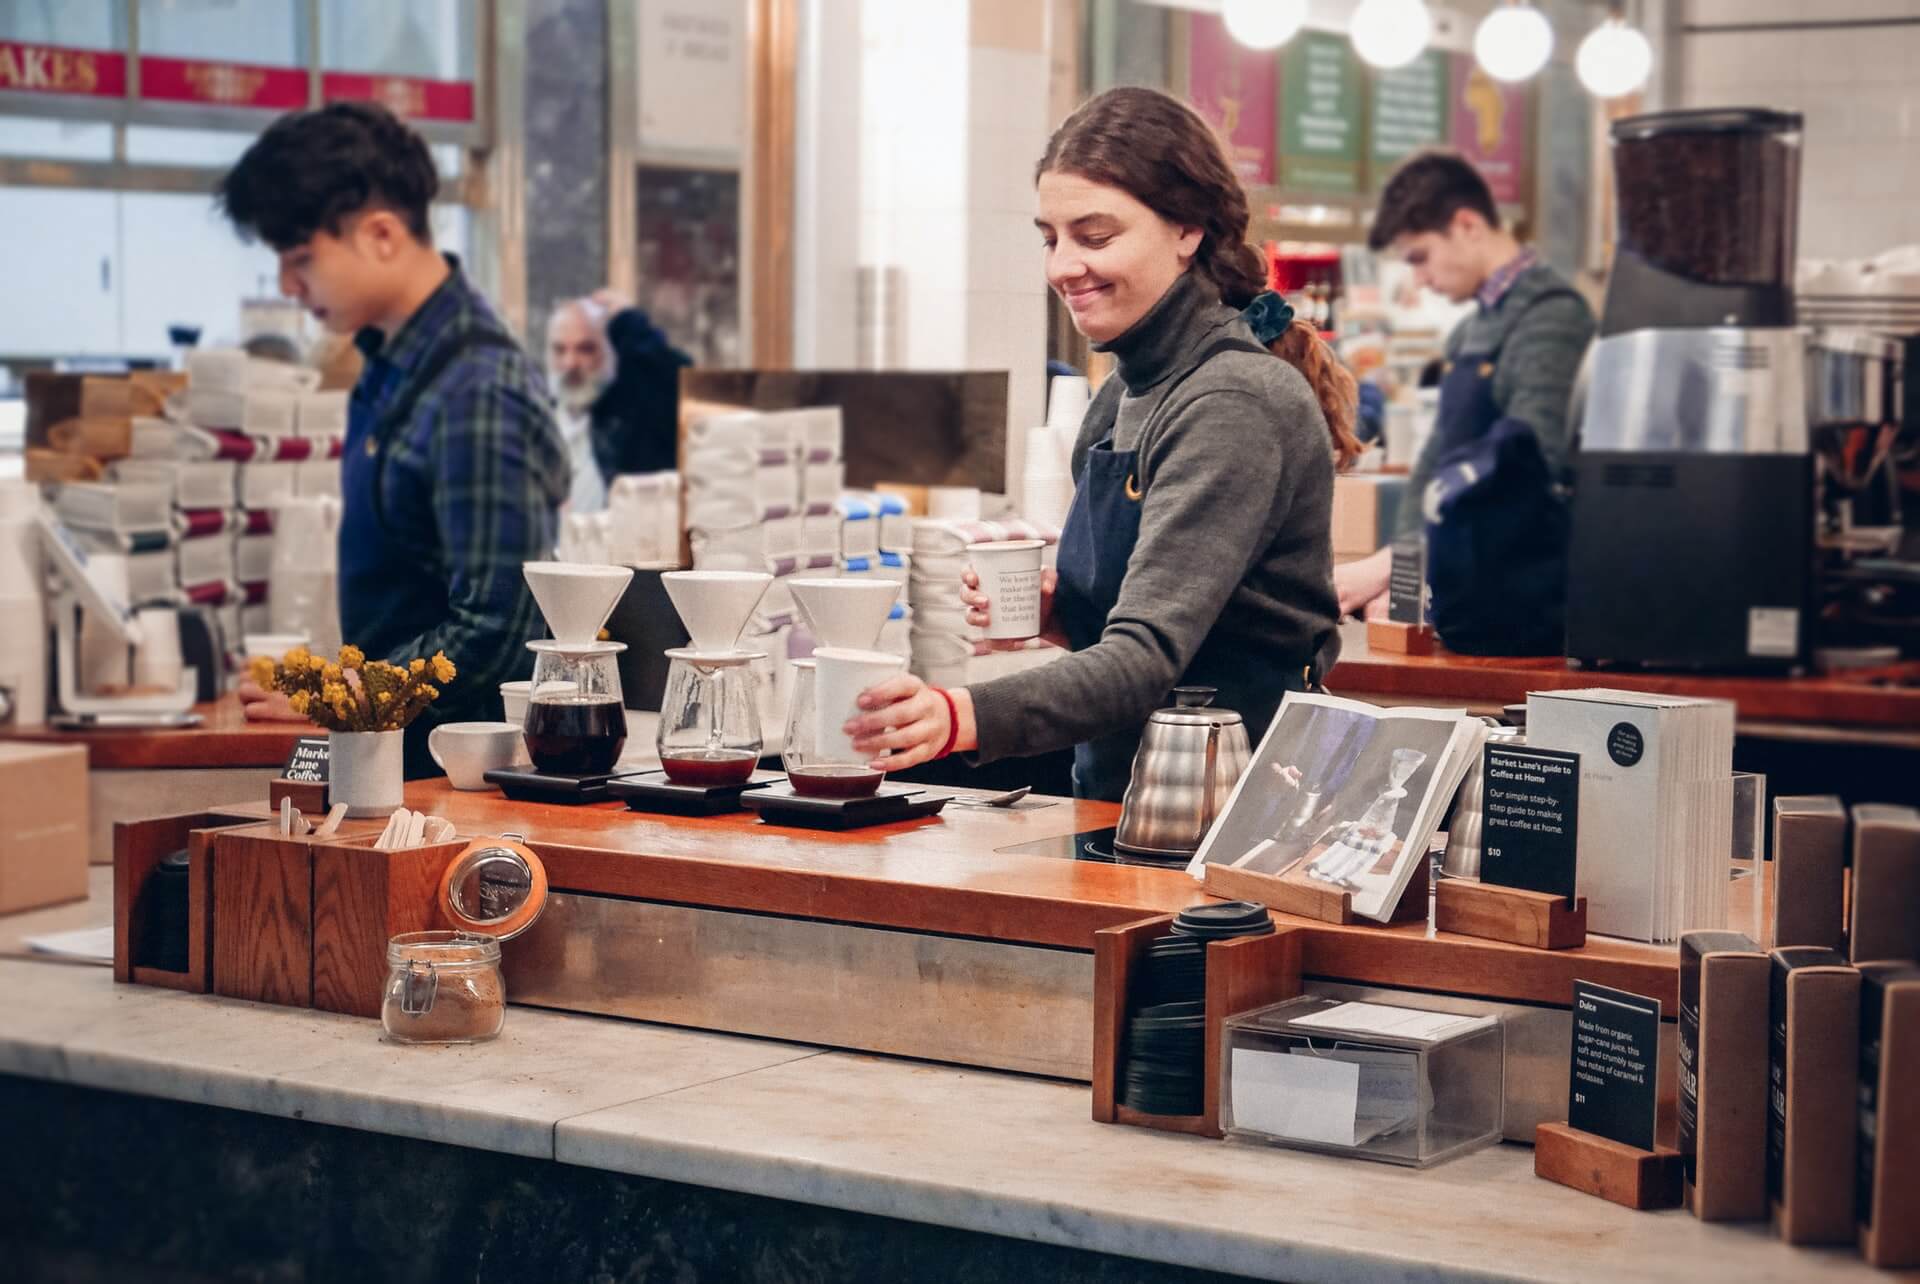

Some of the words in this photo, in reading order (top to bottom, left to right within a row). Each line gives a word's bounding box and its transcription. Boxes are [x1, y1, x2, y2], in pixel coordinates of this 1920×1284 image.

[295, 746, 330, 760] Marke
[290, 758, 320, 770] Lane
[1490, 757, 1517, 768] Market
[1518, 760, 1541, 771] Lane's
[1542, 764, 1562, 774] guide
[1563, 766, 1572, 775] to
[286, 769, 323, 782] Coffee
[1490, 768, 1514, 779] Coffee
[1514, 772, 1524, 781] at
[1524, 773, 1546, 784] Home
[1489, 788, 1505, 798] Our
[1505, 791, 1529, 802] simple
[1489, 803, 1506, 813] step
[1506, 806, 1527, 815] guide
[1527, 808, 1536, 817] to
[1536, 810, 1562, 822] making
[1488, 817, 1509, 826] great
[1509, 820, 1532, 830] coffee
[1532, 823, 1541, 831] at
[1541, 824, 1563, 834] home.
[1487, 847, 1502, 857] $10
[1579, 999, 1597, 1013] Dulce
[1578, 1019, 1595, 1032] Made
[1595, 1023, 1610, 1036] from
[1610, 1029, 1633, 1042] organic
[1577, 1046, 1590, 1056] soft
[1590, 1049, 1602, 1058] and
[1602, 1053, 1627, 1067] crumbly
[1627, 1060, 1646, 1071] sugar
[1627, 1046, 1640, 1057] this
[1576, 1057, 1588, 1067] has
[1588, 1061, 1605, 1073] notes
[1605, 1066, 1613, 1074] of
[1613, 1069, 1638, 1082] caramel
[1575, 1092, 1586, 1104] $11
